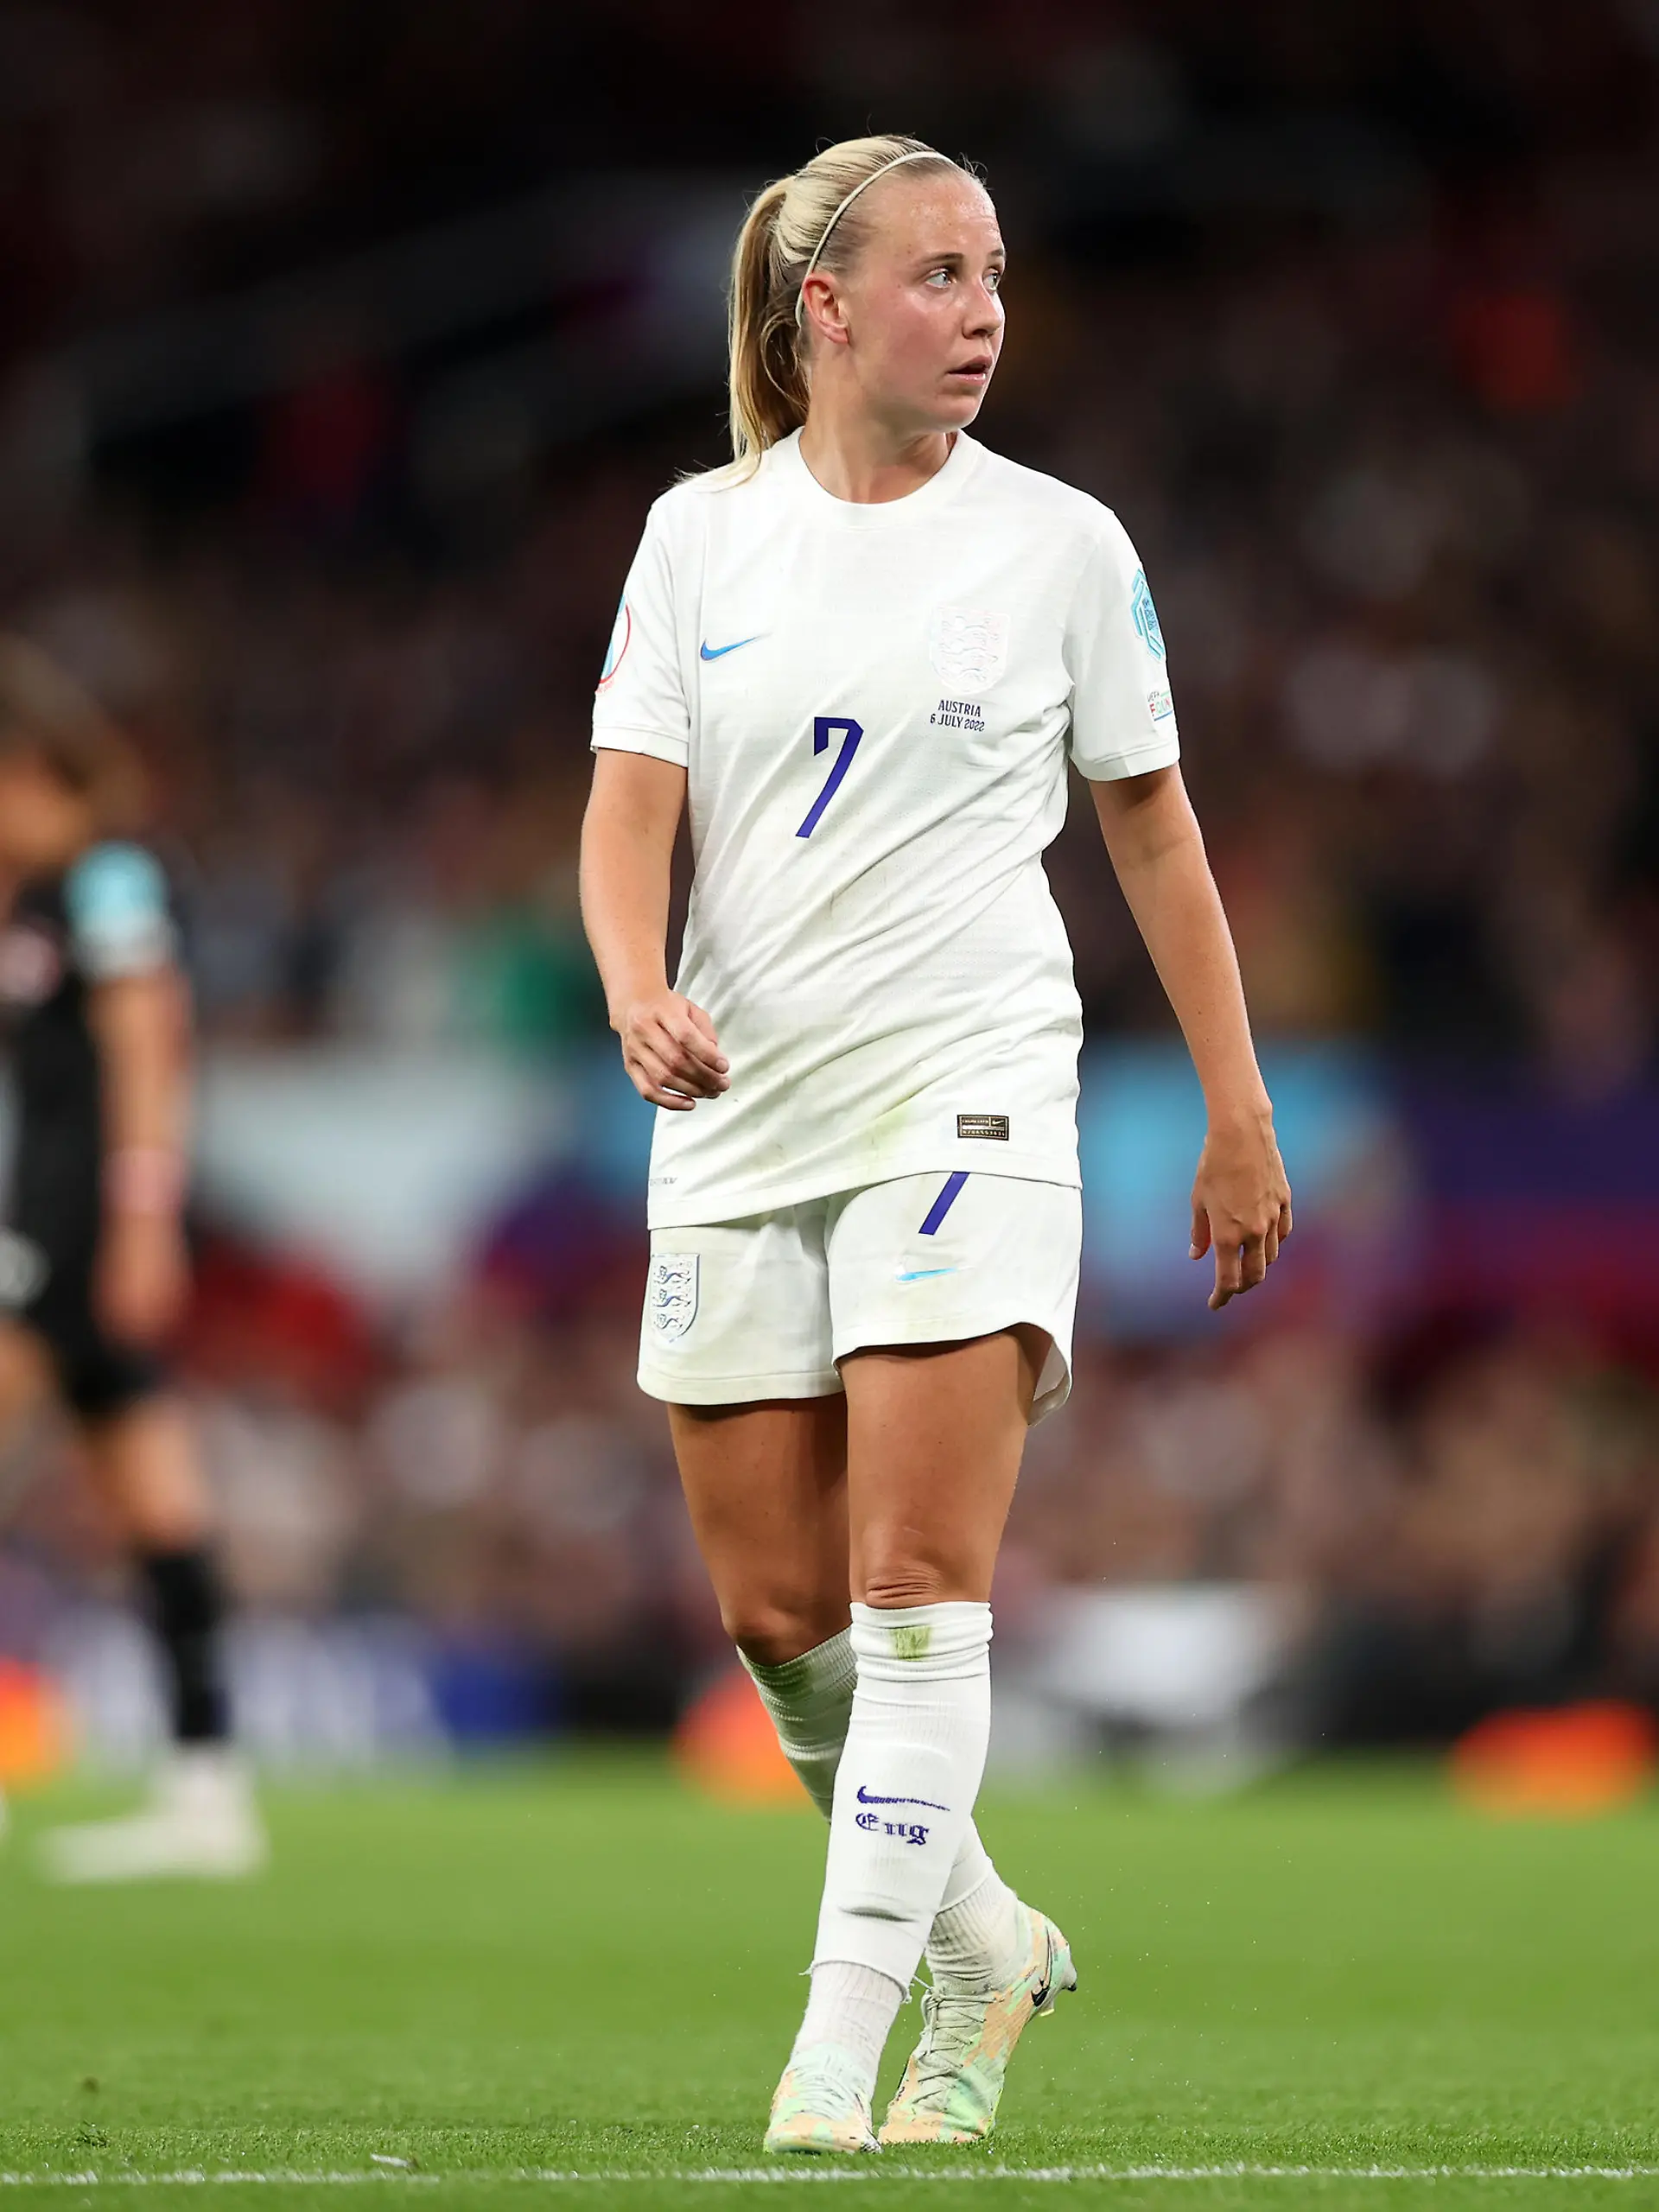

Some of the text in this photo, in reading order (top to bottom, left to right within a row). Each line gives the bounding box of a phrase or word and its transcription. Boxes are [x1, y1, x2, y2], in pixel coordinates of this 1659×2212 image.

[938, 699, 981, 717] AUSTRIA
[930, 713, 985, 732] 6 JULY 2022
[796, 716, 864, 838] 7
[855, 1813, 930, 1846] Eng
